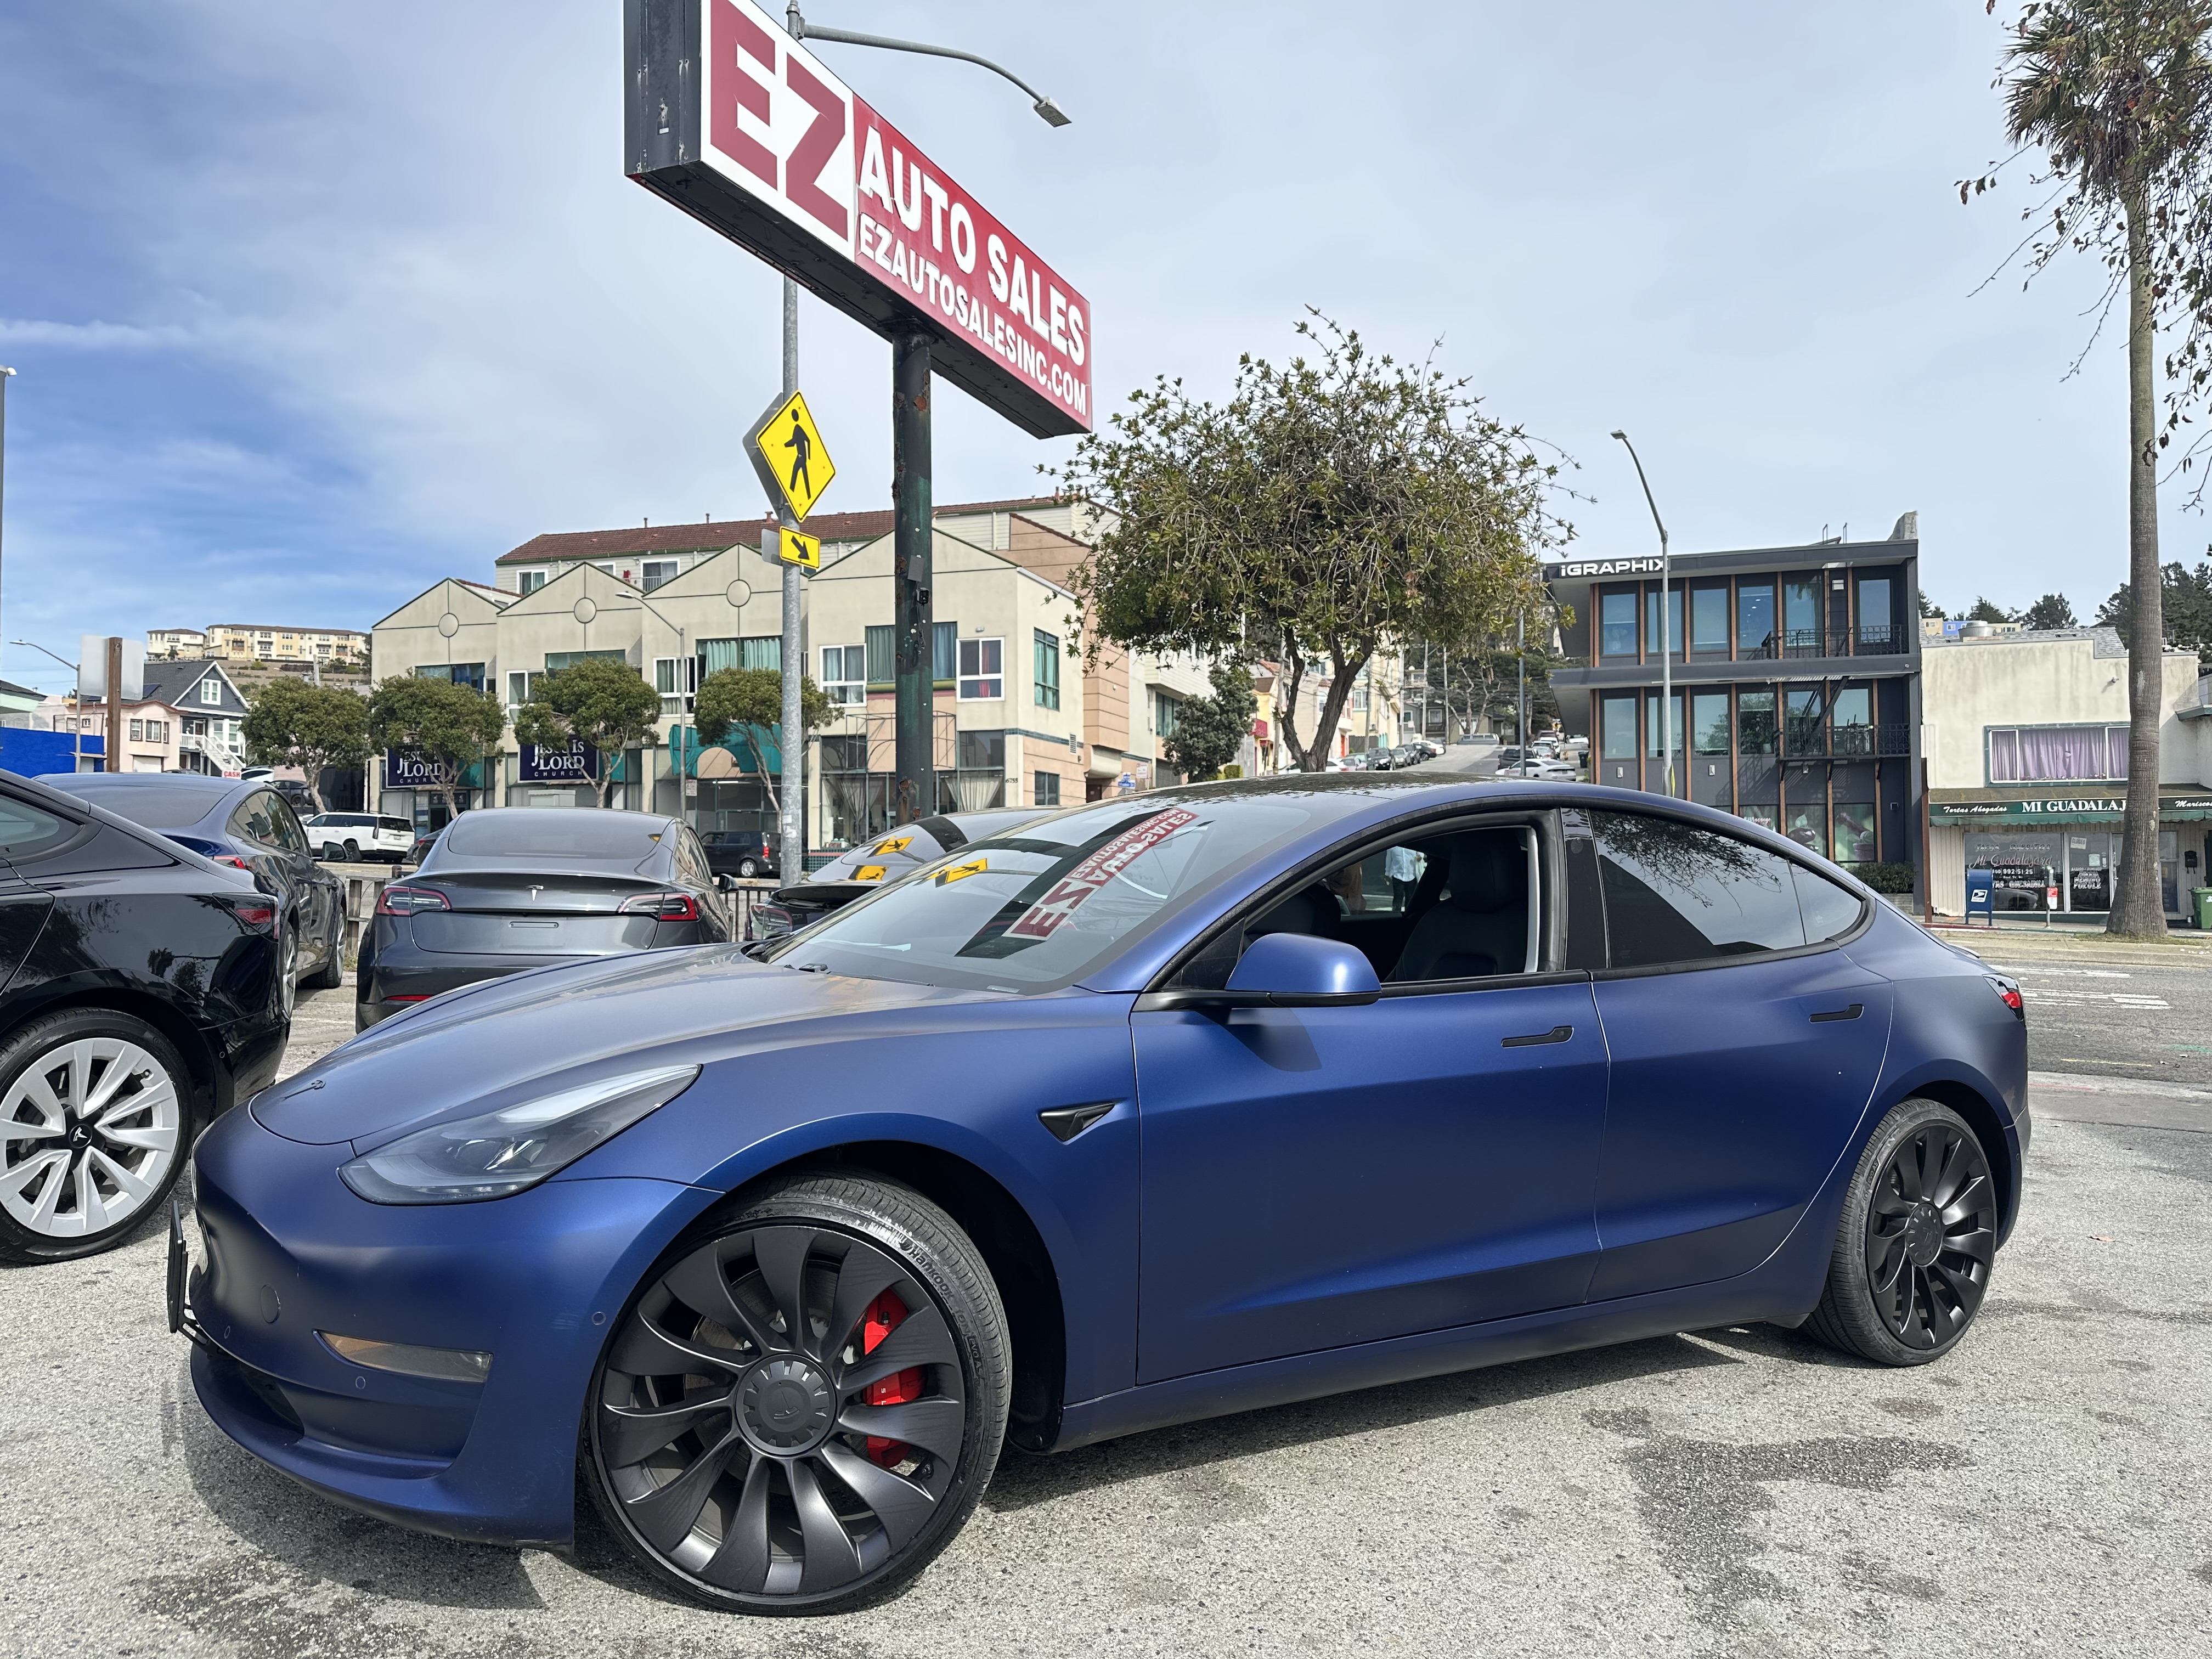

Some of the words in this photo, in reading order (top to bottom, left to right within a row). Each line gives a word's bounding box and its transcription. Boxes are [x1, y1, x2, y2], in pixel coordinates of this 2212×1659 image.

[710, 0, 849, 242] EZ
[859, 125, 976, 274] AUTO
[988, 234, 1085, 366] SALES
[860, 212, 1086, 416] EZAUTOSALESINC.COM
[539, 755, 585, 770] LORD
[1970, 805, 2007, 814] Ahogadas
[2022, 801, 2042, 812] MI
[2046, 799, 2160, 812] GUADALAJ
